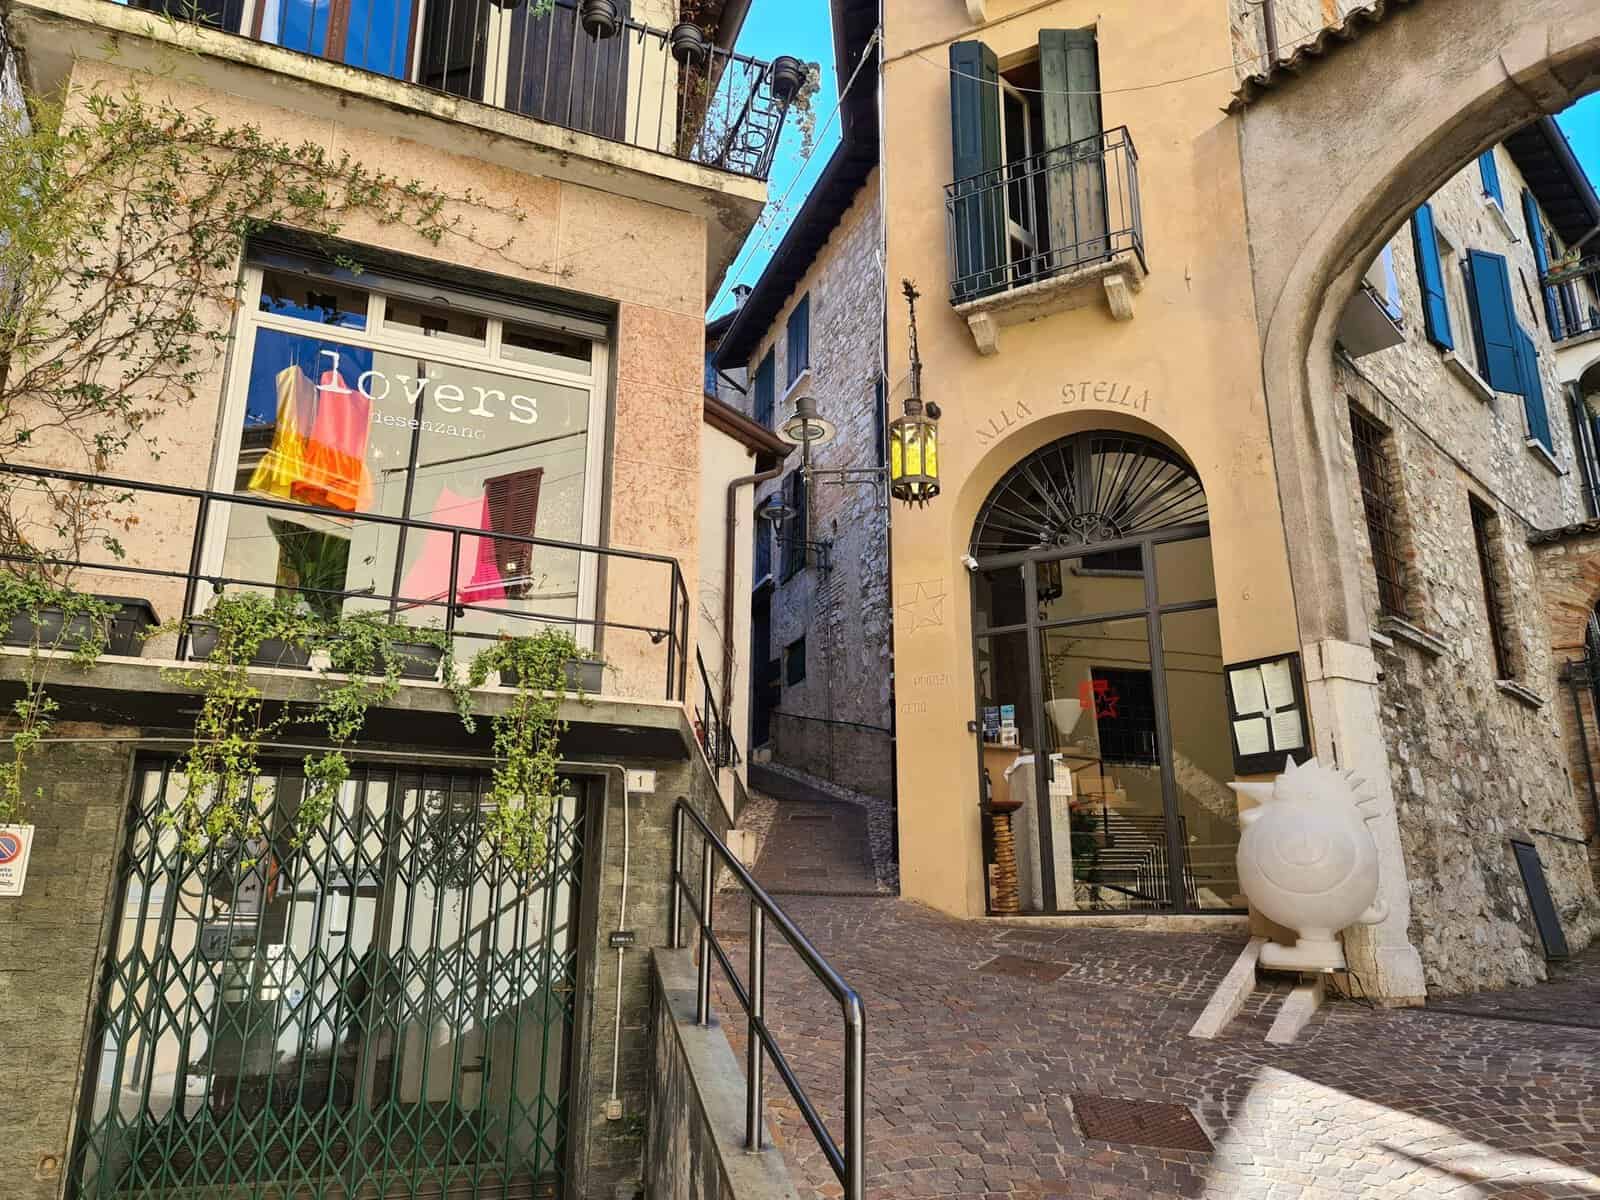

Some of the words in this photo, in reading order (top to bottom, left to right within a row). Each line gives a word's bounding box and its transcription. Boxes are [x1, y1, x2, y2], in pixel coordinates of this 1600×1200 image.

[315, 349, 539, 425] lovers
[975, 399, 1033, 446] ALLA
[1060, 381, 1152, 413] STELLA
[368, 409, 487, 440] desenzano
